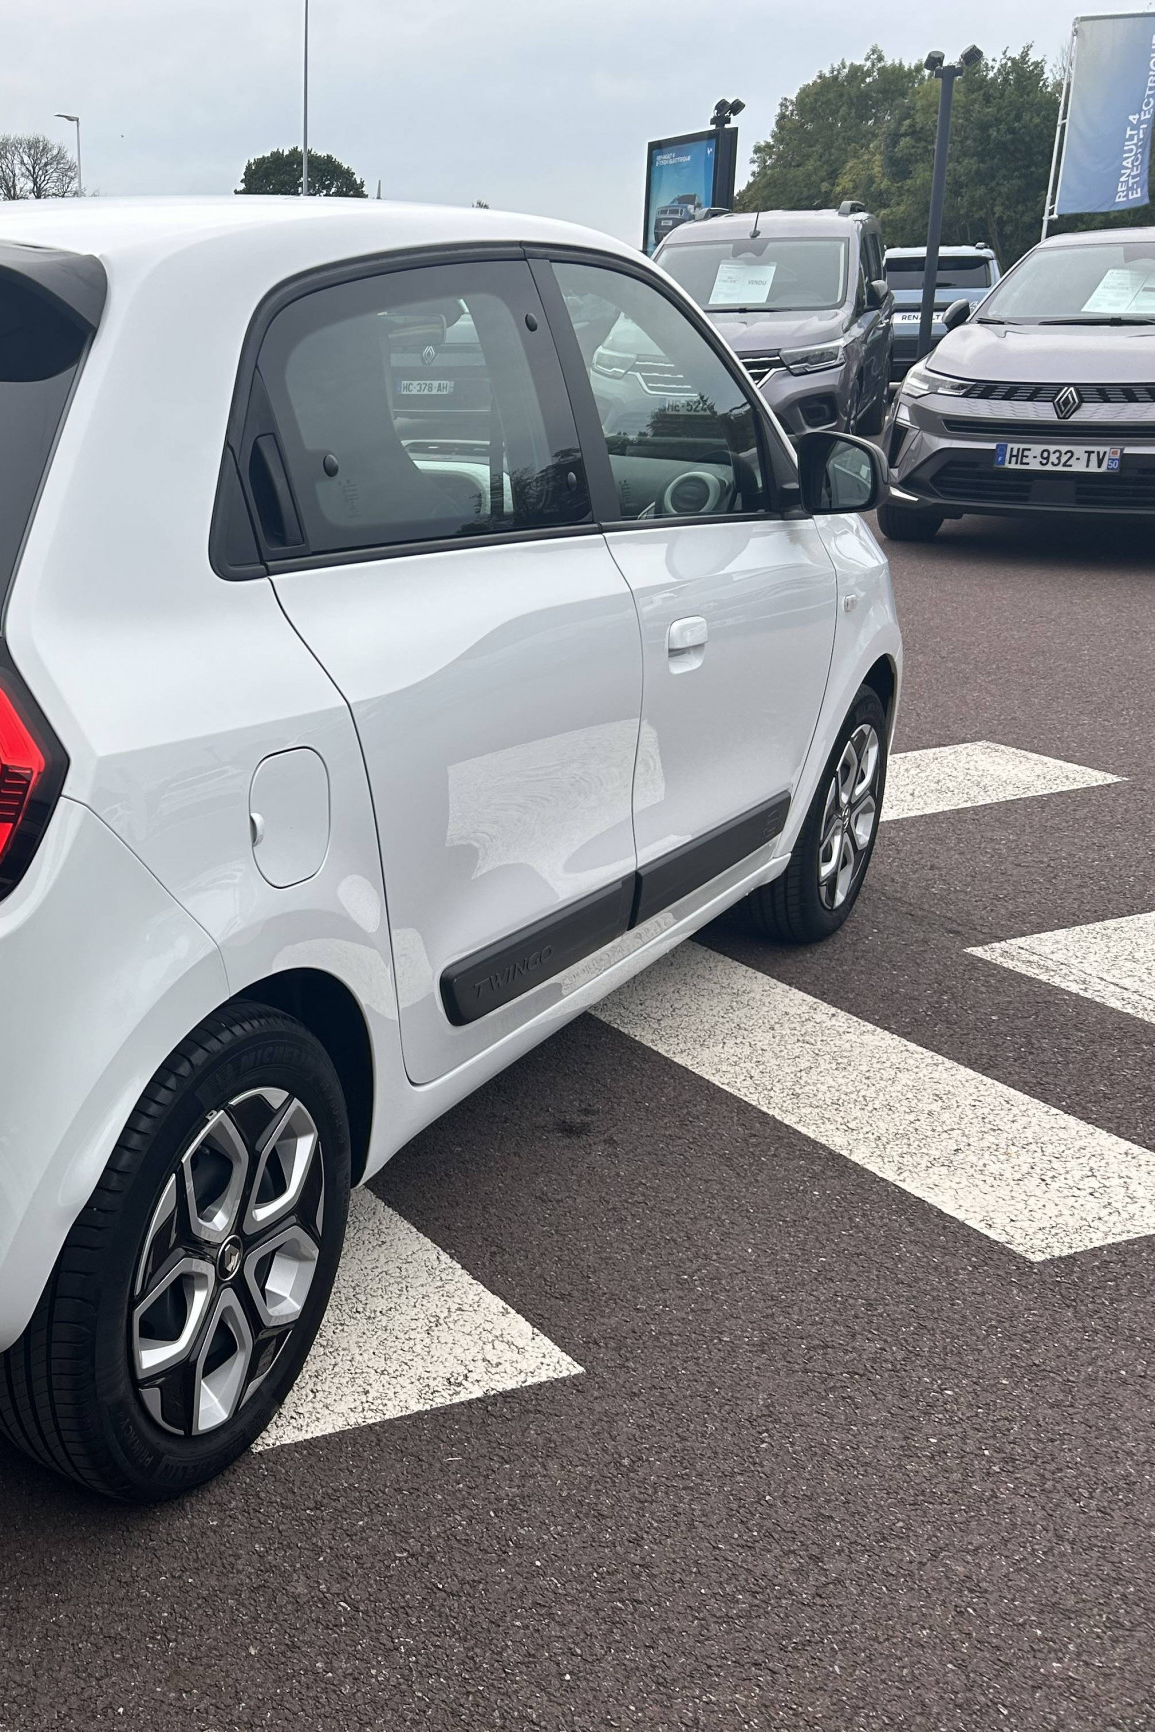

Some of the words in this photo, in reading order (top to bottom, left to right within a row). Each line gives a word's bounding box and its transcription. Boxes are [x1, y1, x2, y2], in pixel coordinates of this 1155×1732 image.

[1115, 126, 1138, 202] RENAULT
[1128, 113, 1140, 125] 4
[402, 382, 448, 393] HC-378-AH
[1008, 447, 1107, 469] HE-932-TV
[1107, 460, 1119, 469] 50
[473, 944, 554, 999] TWINGO
